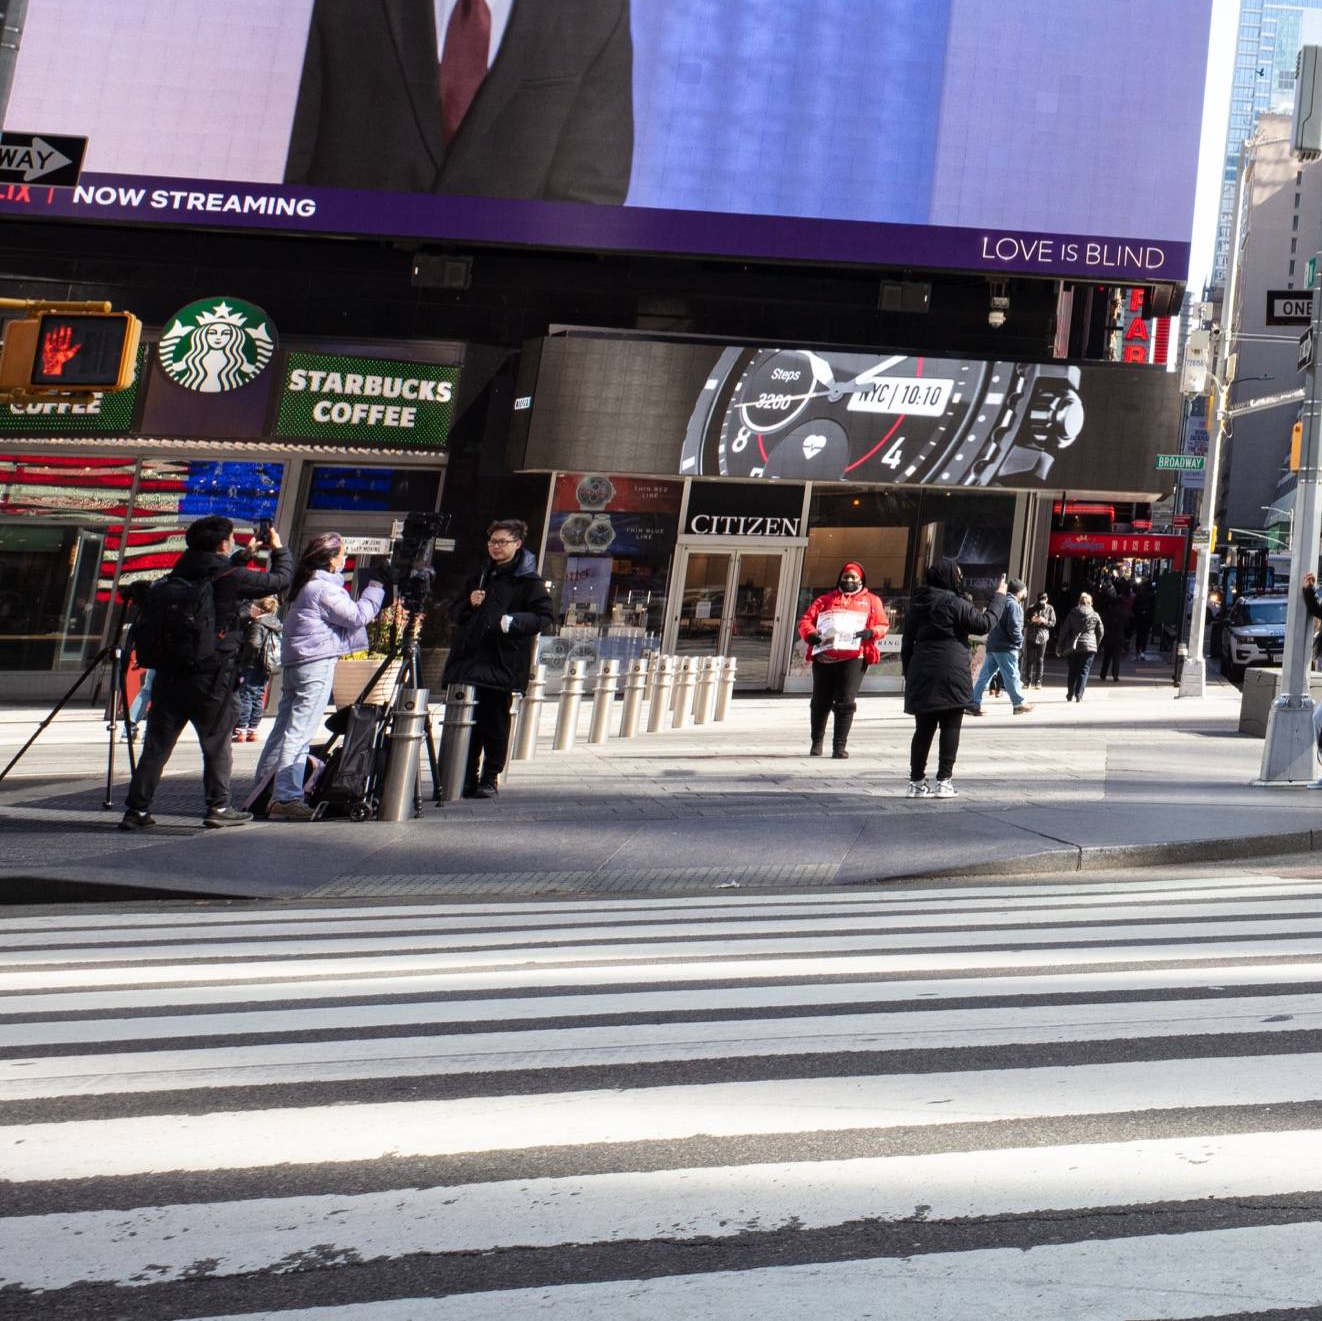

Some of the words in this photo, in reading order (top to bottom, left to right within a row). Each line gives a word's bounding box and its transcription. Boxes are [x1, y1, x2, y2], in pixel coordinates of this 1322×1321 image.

[73, 186, 146, 206] NOW
[150, 191, 316, 217] STREAMING
[981, 237, 1054, 262] LOVE
[1060, 243, 1078, 262] IS
[1085, 242, 1165, 269] BLIND
[288, 369, 452, 403] STARBUCKS
[770, 368, 801, 382] Steps
[859, 381, 889, 404] NYC
[900, 385, 941, 407] 10:10
[313, 400, 417, 428] COFFEE
[731, 427, 750, 453] 8
[881, 436, 903, 470] 4
[1158, 457, 1202, 469] BROADWAY
[690, 514, 800, 537] CITIZEN
[1111, 540, 1161, 551] DINER
